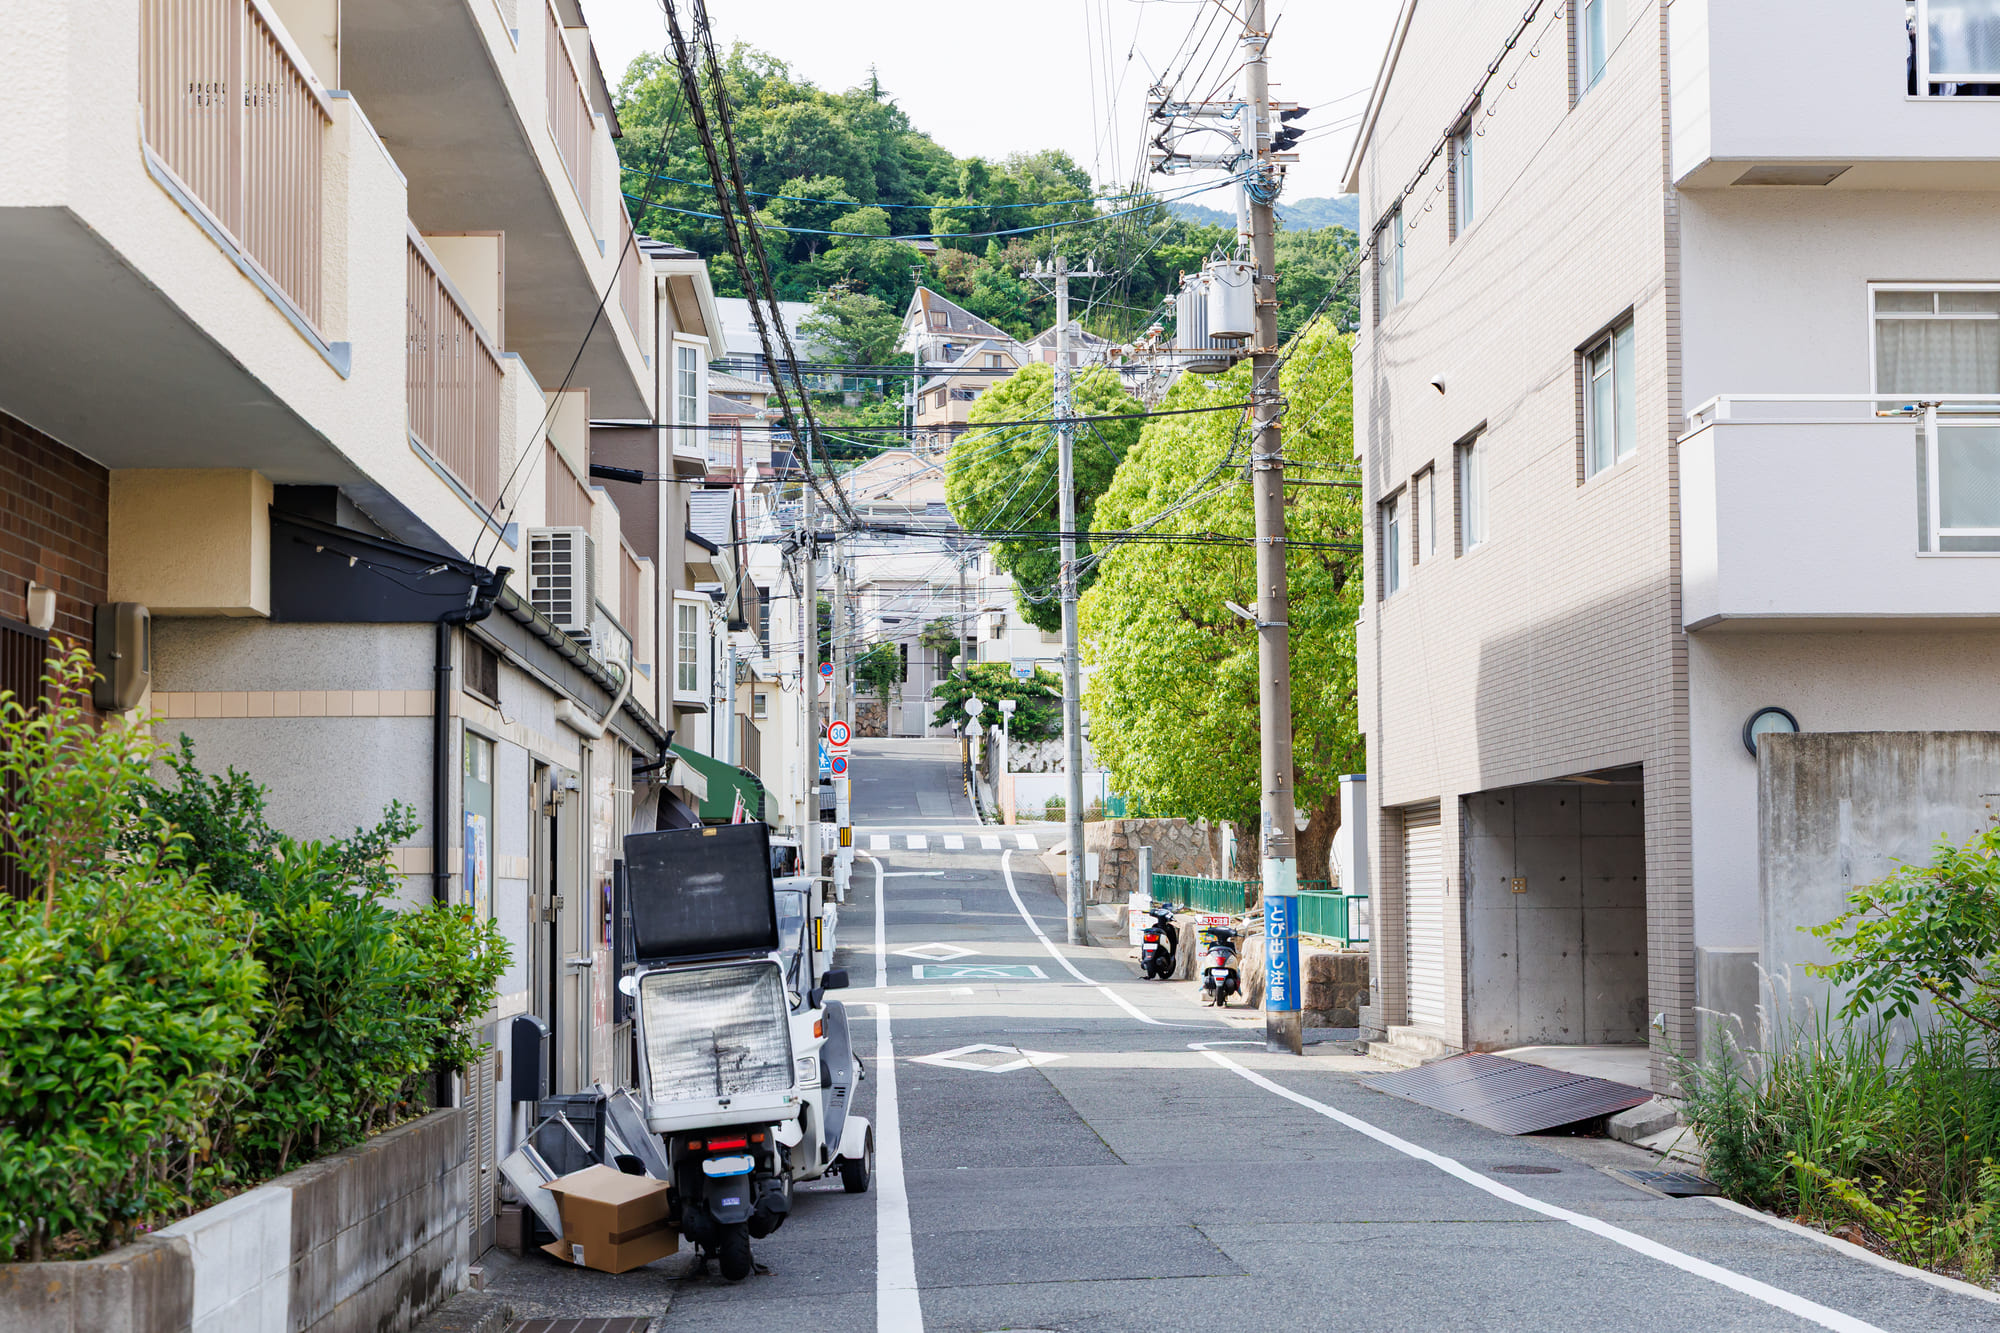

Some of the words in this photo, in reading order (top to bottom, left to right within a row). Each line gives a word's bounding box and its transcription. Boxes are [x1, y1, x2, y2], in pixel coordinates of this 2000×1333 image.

[832, 727, 846, 740] 30
[1270, 906, 1285, 1001] とび出し注意
